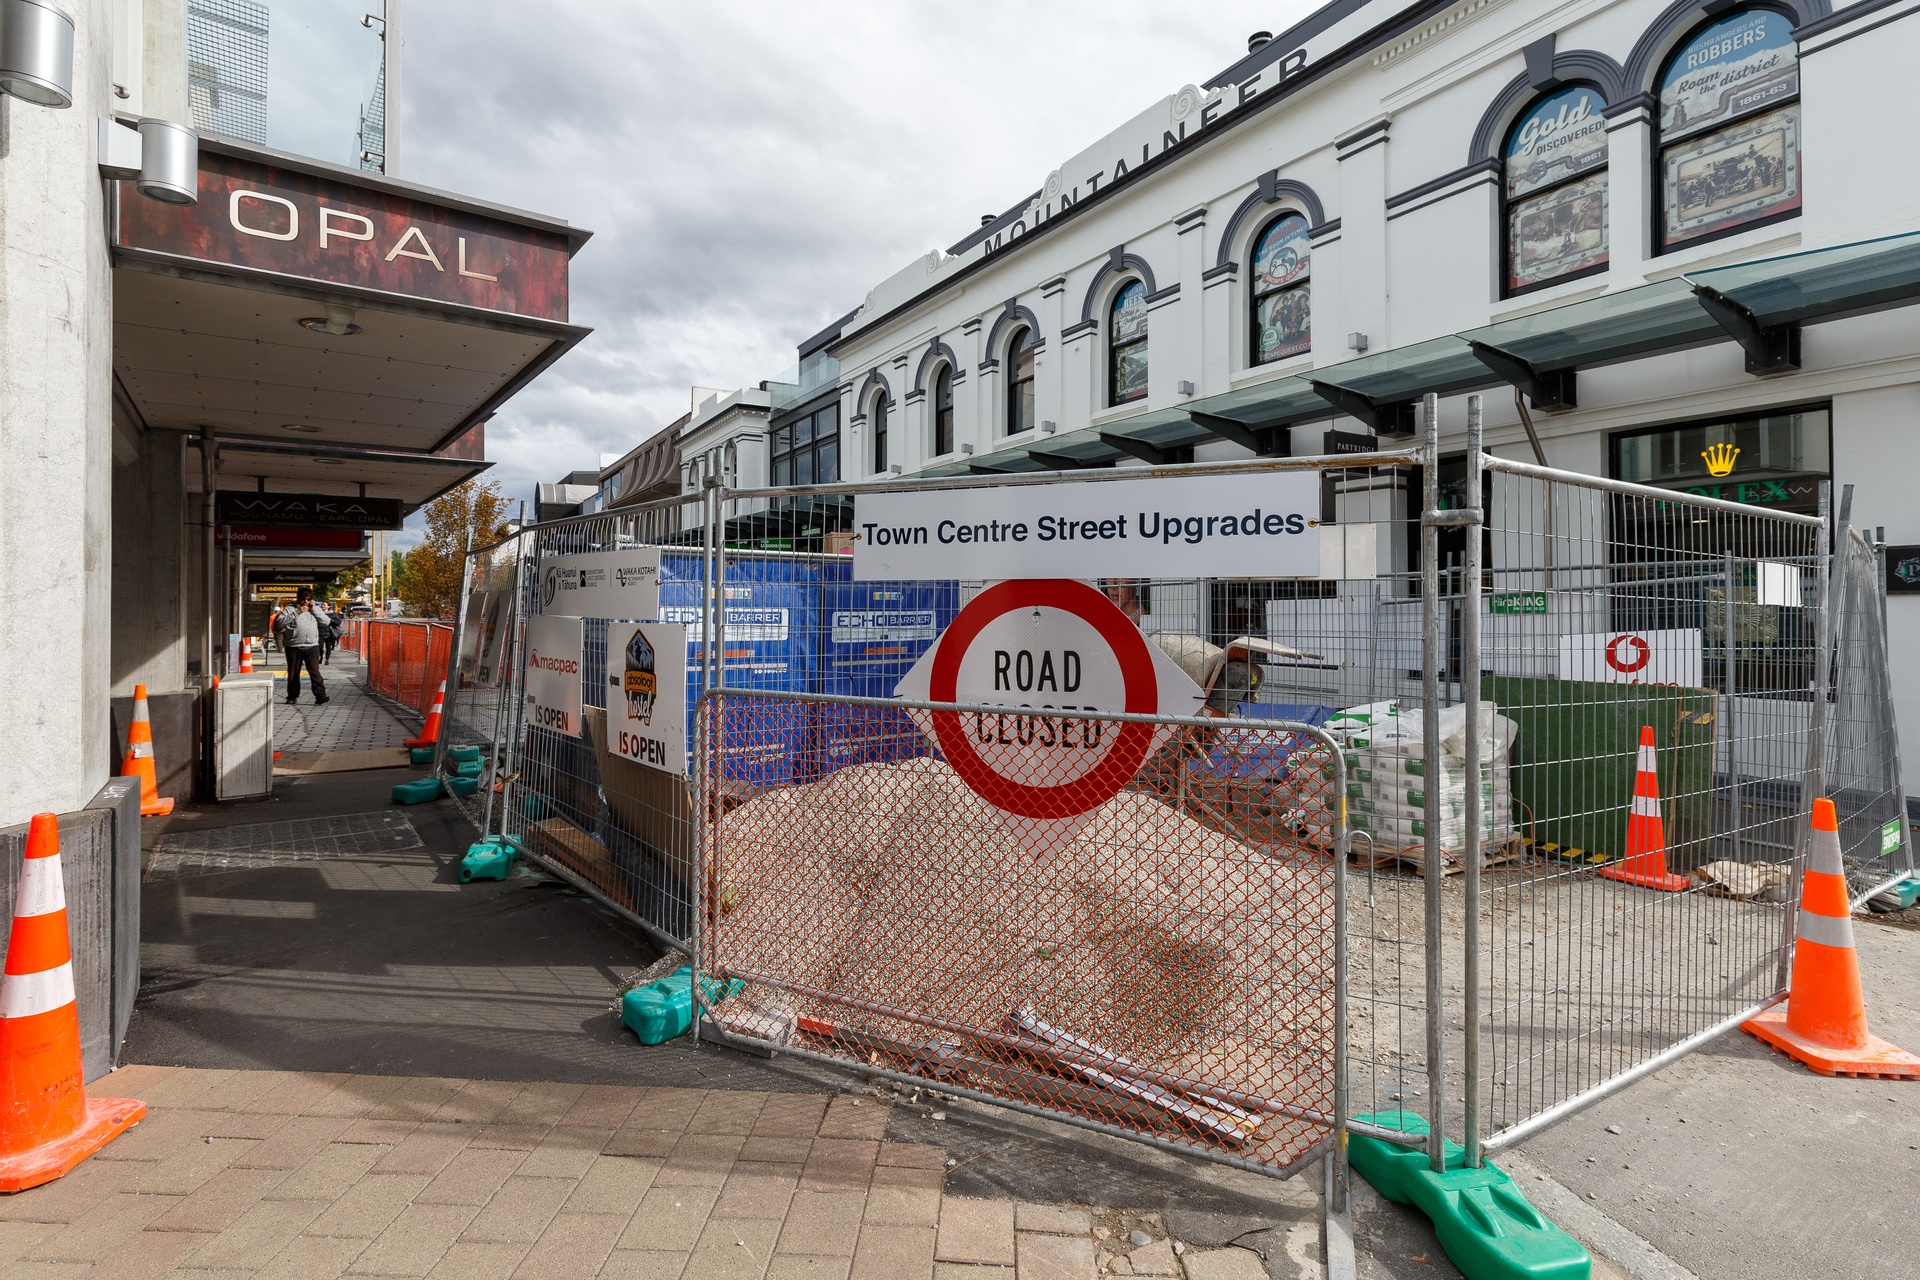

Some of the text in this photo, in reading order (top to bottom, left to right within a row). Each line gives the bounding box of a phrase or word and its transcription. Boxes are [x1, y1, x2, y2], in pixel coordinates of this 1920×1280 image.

[1688, 15, 1767, 54] BUSHRANGERS AND
[1687, 25, 1767, 69] ROBBERS
[1678, 54, 1780, 95] Roam the district
[1739, 83, 1787, 106] 1861-63
[1519, 95, 1593, 156] Gold
[1536, 119, 1606, 156] DISCOVERED!
[984, 48, 1307, 255] MOUNTAINEER
[1580, 151, 1602, 164] 1861
[229, 189, 498, 283] OPAL
[1265, 221, 1299, 247] ESCAPE
[1268, 219, 1292, 237] CAN YOU
[1269, 238, 1284, 250] ROOM
[1291, 224, 1308, 237] TIME?
[1266, 263, 1302, 284] ESCAPE QUEST
[1124, 293, 1143, 308] REES
[1337, 442, 1375, 452] PARTRIDGE
[230, 510, 391, 524] POUNAMU PEARL OPAL
[234, 499, 368, 515] WAKA
[217, 533, 266, 541] vdafone
[862, 508, 1305, 546] Town Centre Street Upgrades
[562, 566, 577, 578] Huanui
[623, 566, 656, 576] WAKA KOTAHI
[1491, 596, 1545, 607] HireKING
[666, 611, 725, 624] ECH
[838, 615, 931, 627] ECHO BARRER
[540, 656, 578, 676] macpac
[994, 649, 1081, 693] ROAD
[626, 674, 654, 688] absoloot
[628, 688, 653, 718] hostel
[535, 704, 569, 732] IS OPEN
[977, 703, 1101, 749] CLOSED
[619, 731, 666, 766] IS OPEN
